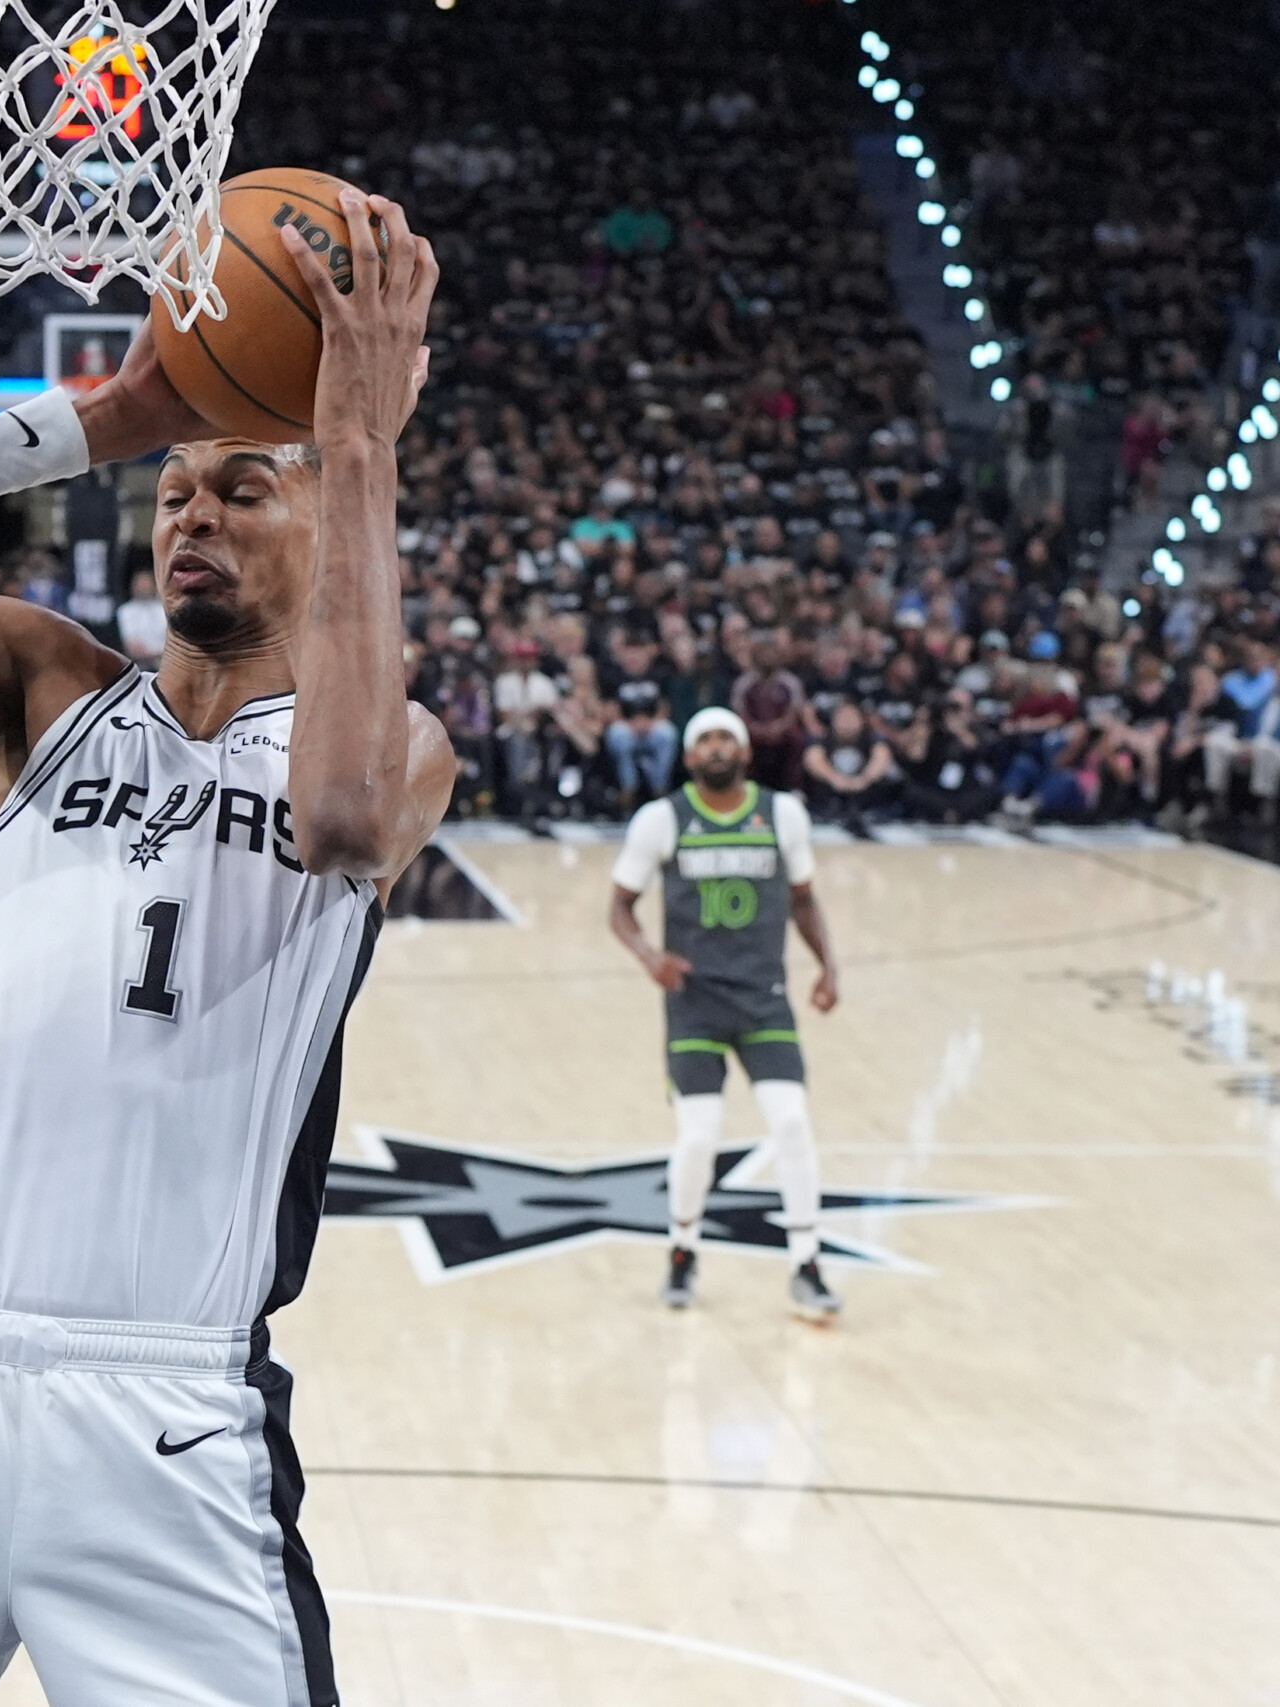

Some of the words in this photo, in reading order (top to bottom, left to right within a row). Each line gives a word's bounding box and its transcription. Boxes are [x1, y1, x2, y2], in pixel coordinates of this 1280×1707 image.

[241, 735, 290, 753] LEDGE
[697, 877, 759, 930] 10
[120, 896, 187, 1023] 1
